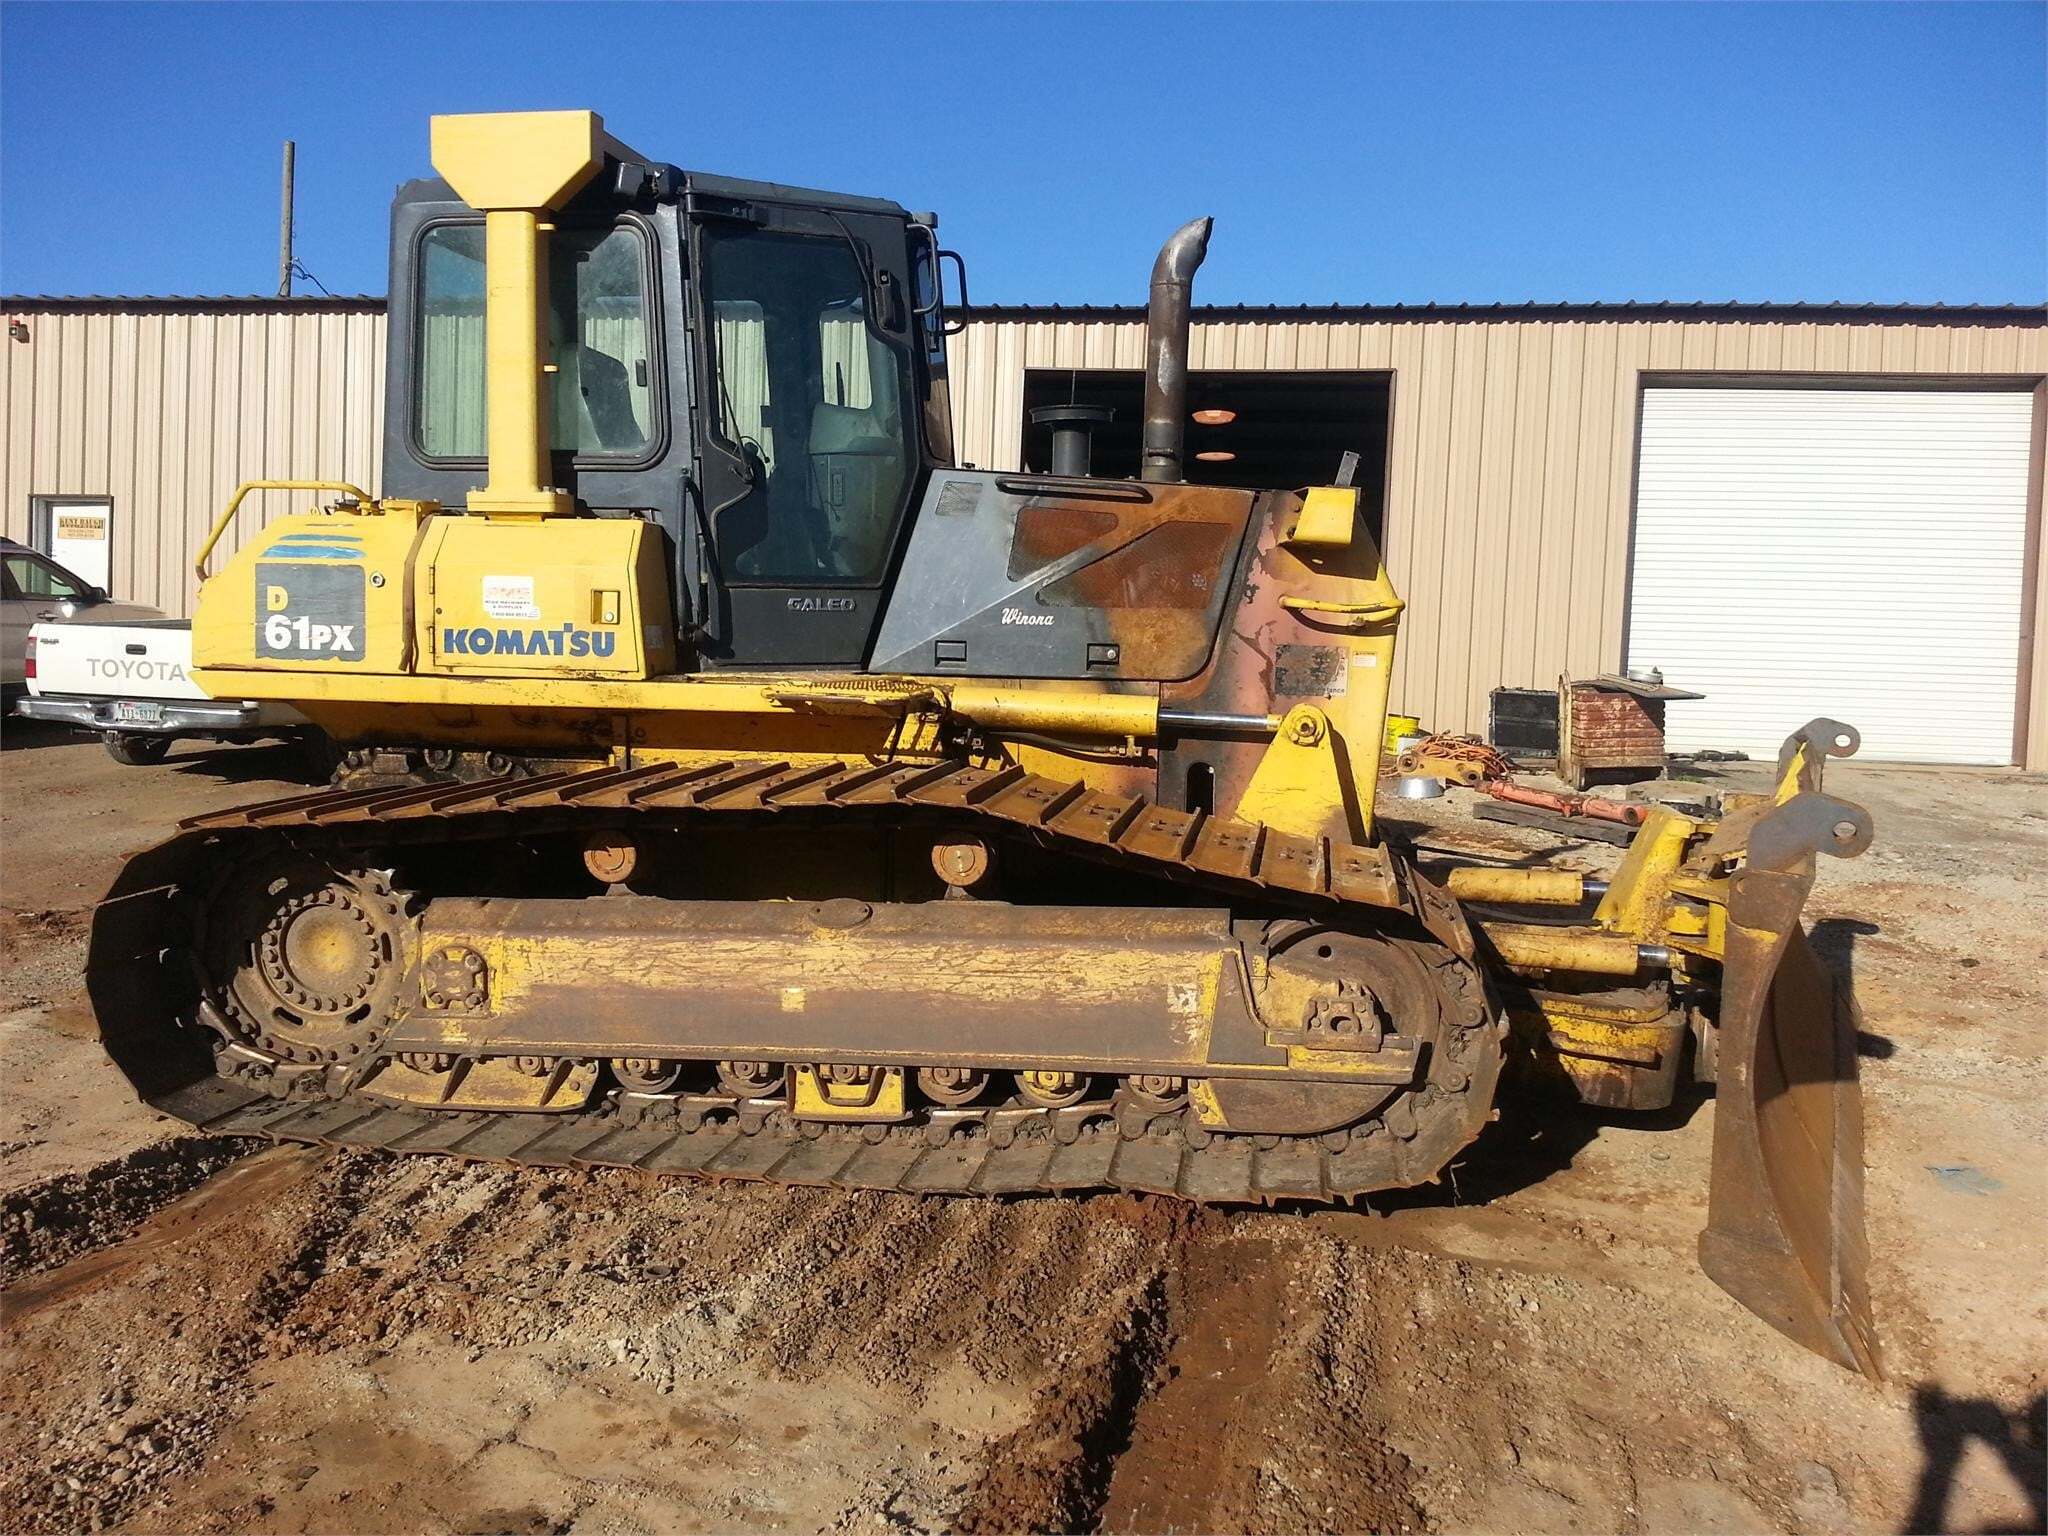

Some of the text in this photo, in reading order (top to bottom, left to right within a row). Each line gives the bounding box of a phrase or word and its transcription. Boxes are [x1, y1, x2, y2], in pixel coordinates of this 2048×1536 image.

[266, 585, 289, 611] D
[787, 597, 856, 611] GALEO
[1002, 607, 1054, 625] Winona
[264, 614, 355, 651] 61PX
[444, 623, 615, 657] KOMATSU
[86, 658, 186, 681] TOYOTA
